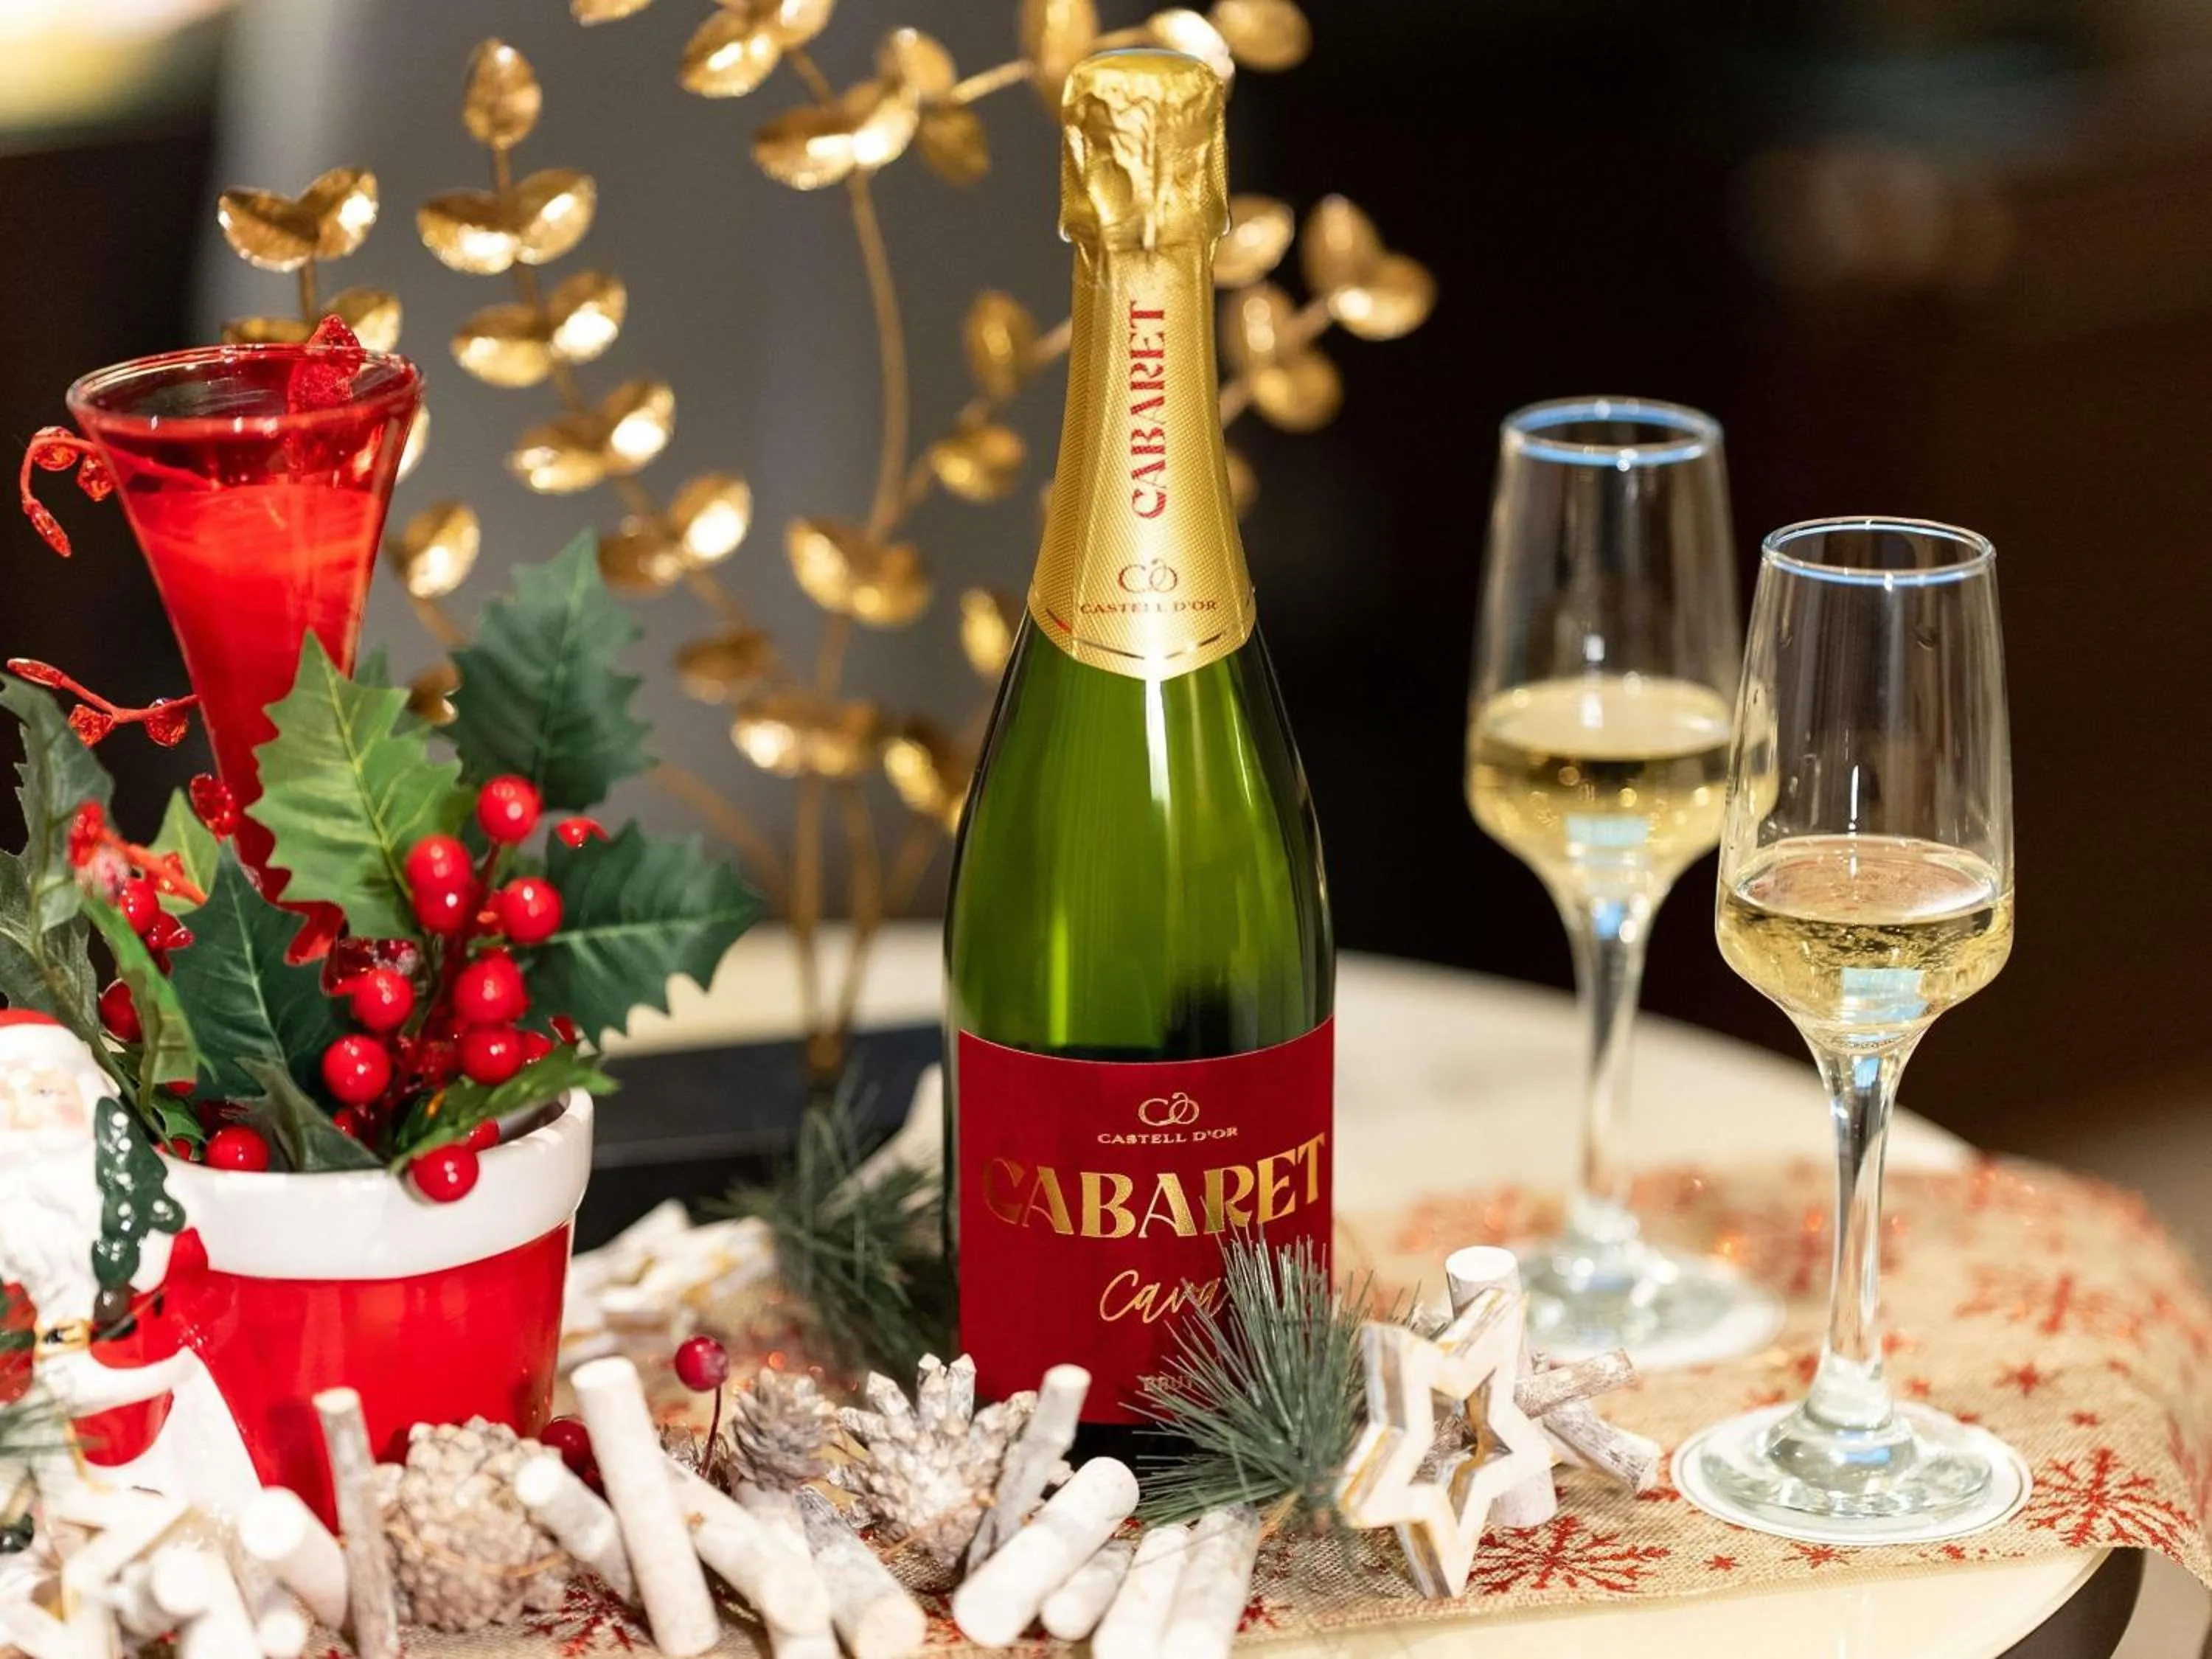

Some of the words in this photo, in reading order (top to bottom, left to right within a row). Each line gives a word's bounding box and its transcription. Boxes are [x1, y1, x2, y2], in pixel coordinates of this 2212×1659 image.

[1130, 300, 1166, 519] CABARET
[1174, 599, 1217, 612] D'OR
[1097, 1133, 1187, 1144] CASTELL
[1192, 1127, 1239, 1141] D'OR
[983, 1133, 1325, 1238] CABARET
[1099, 1270, 1231, 1324] Cava
